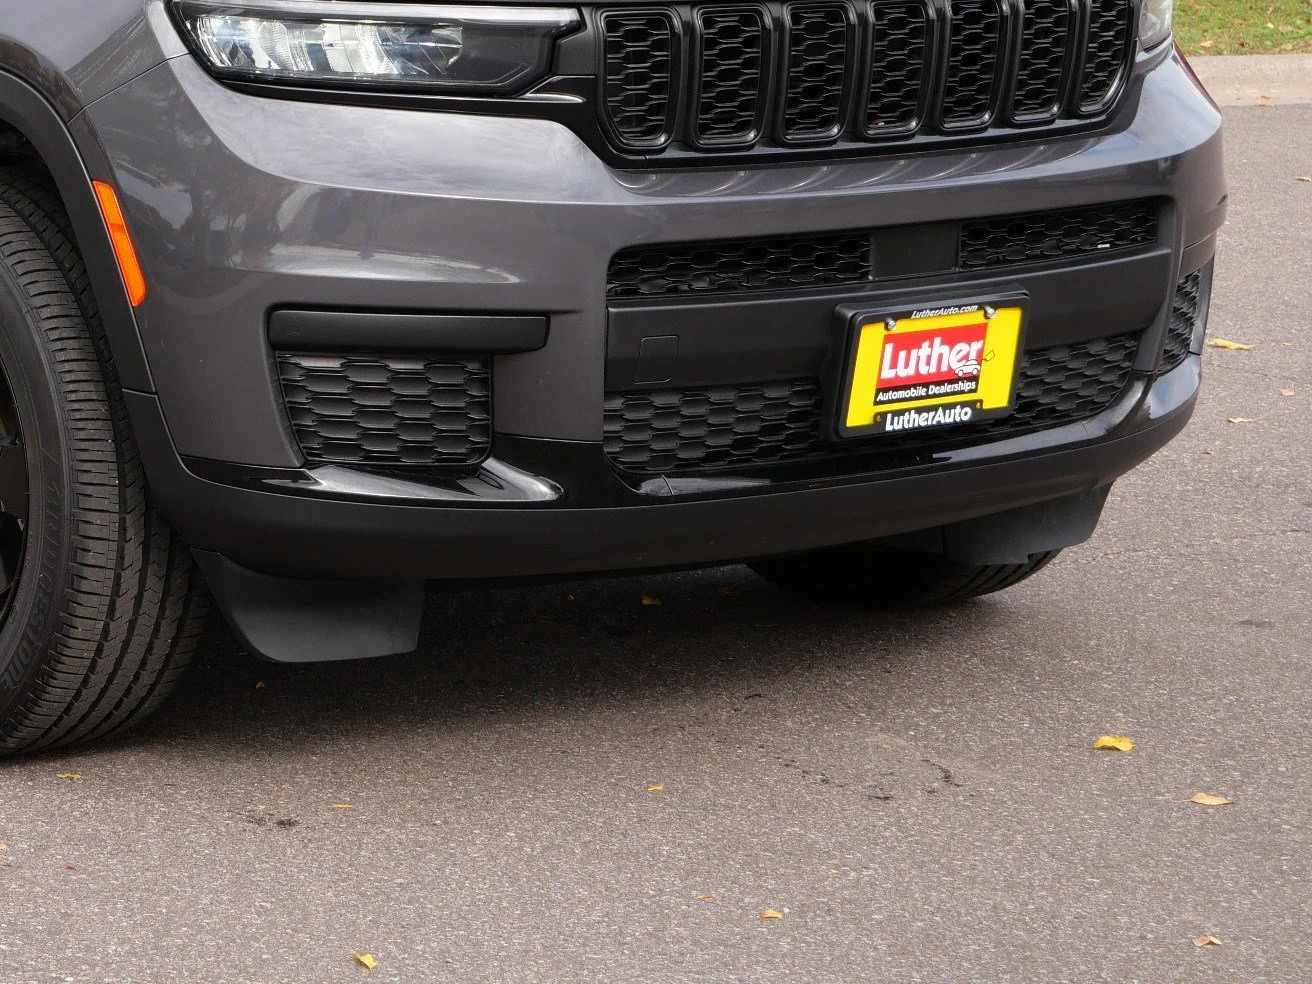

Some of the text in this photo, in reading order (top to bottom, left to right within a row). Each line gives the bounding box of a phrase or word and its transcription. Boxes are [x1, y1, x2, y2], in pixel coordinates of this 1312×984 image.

[910, 304, 979, 319] LutherAuto.com
[880, 336, 984, 380] Luther
[876, 380, 977, 402] Automobile Dealerships
[885, 405, 972, 431] LutherAuto
